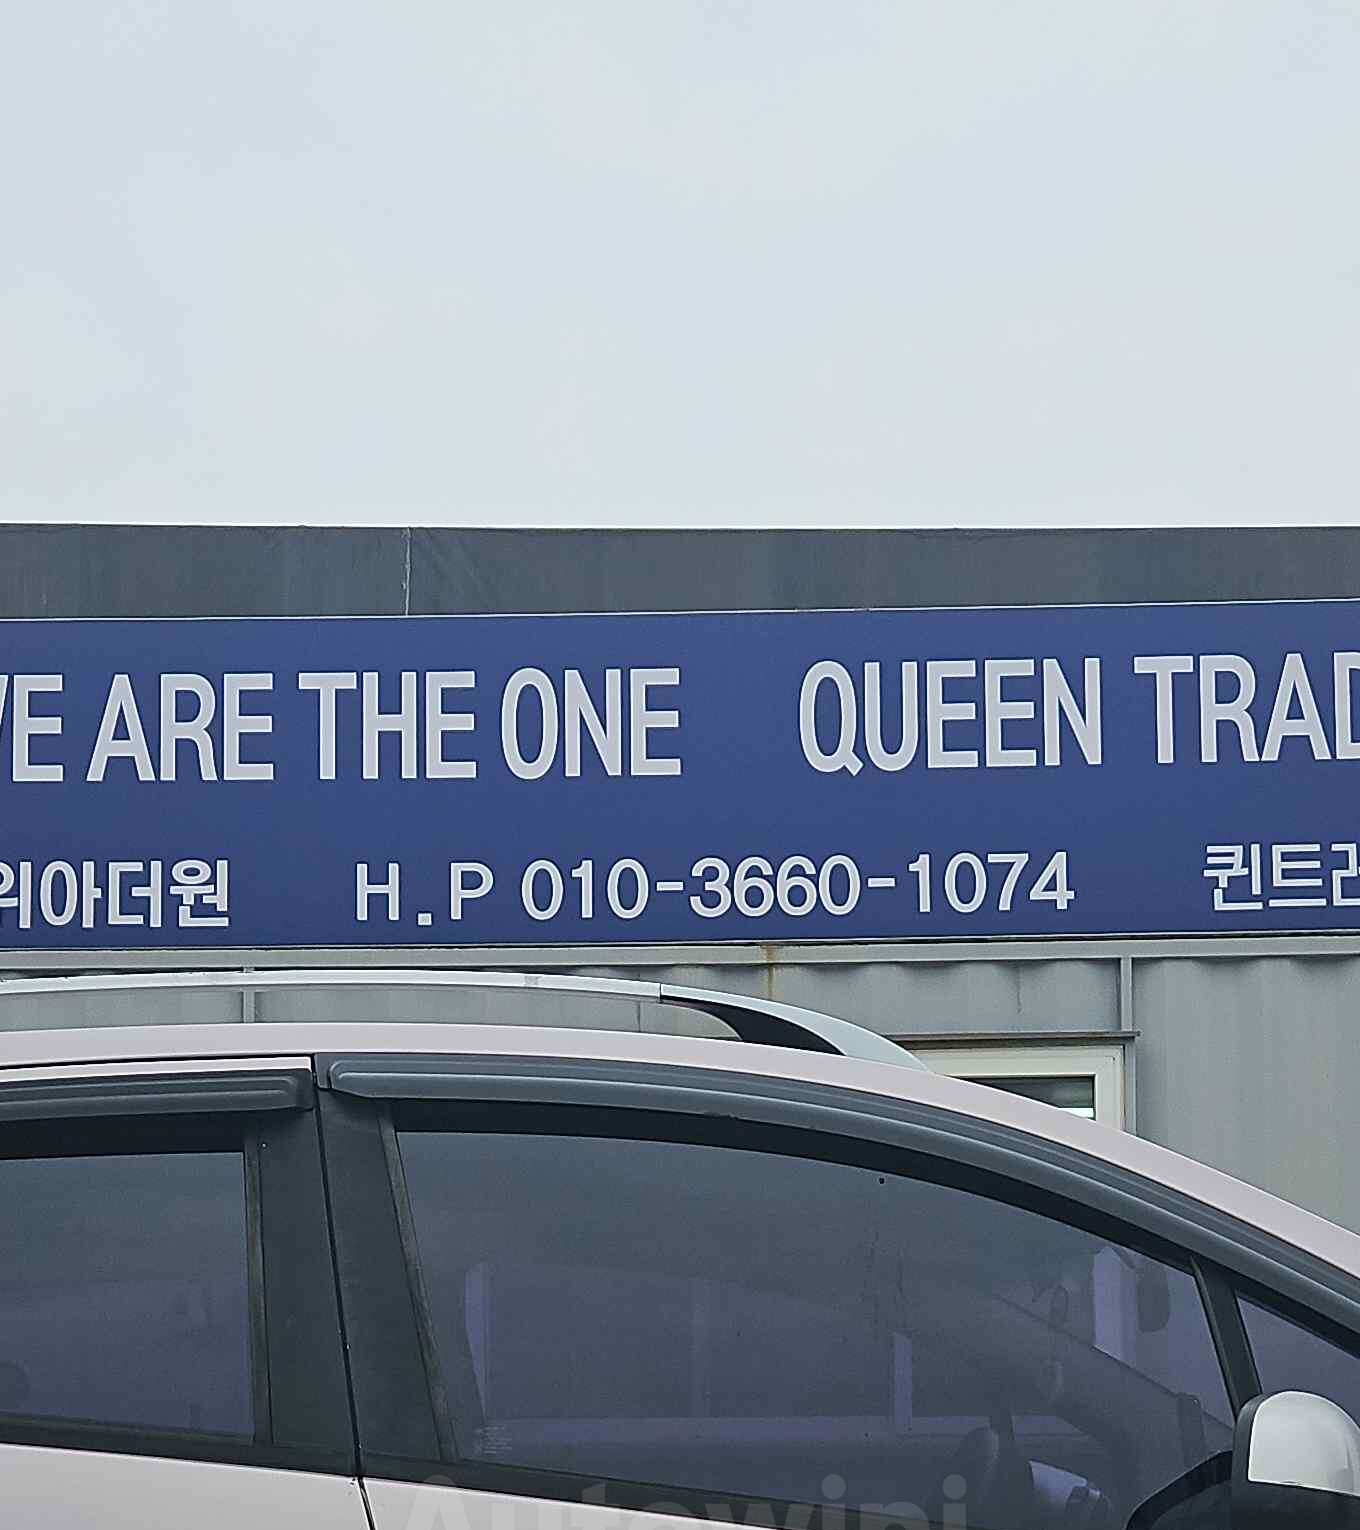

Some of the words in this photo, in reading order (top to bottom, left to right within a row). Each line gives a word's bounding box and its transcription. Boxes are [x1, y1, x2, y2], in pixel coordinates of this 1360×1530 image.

[86, 672, 275, 782] ARE
[297, 669, 477, 780] THE
[500, 667, 683, 780] ONE
[798, 656, 1103, 776] QUEEN
[521, 850, 1076, 921] 010-3660-1074
